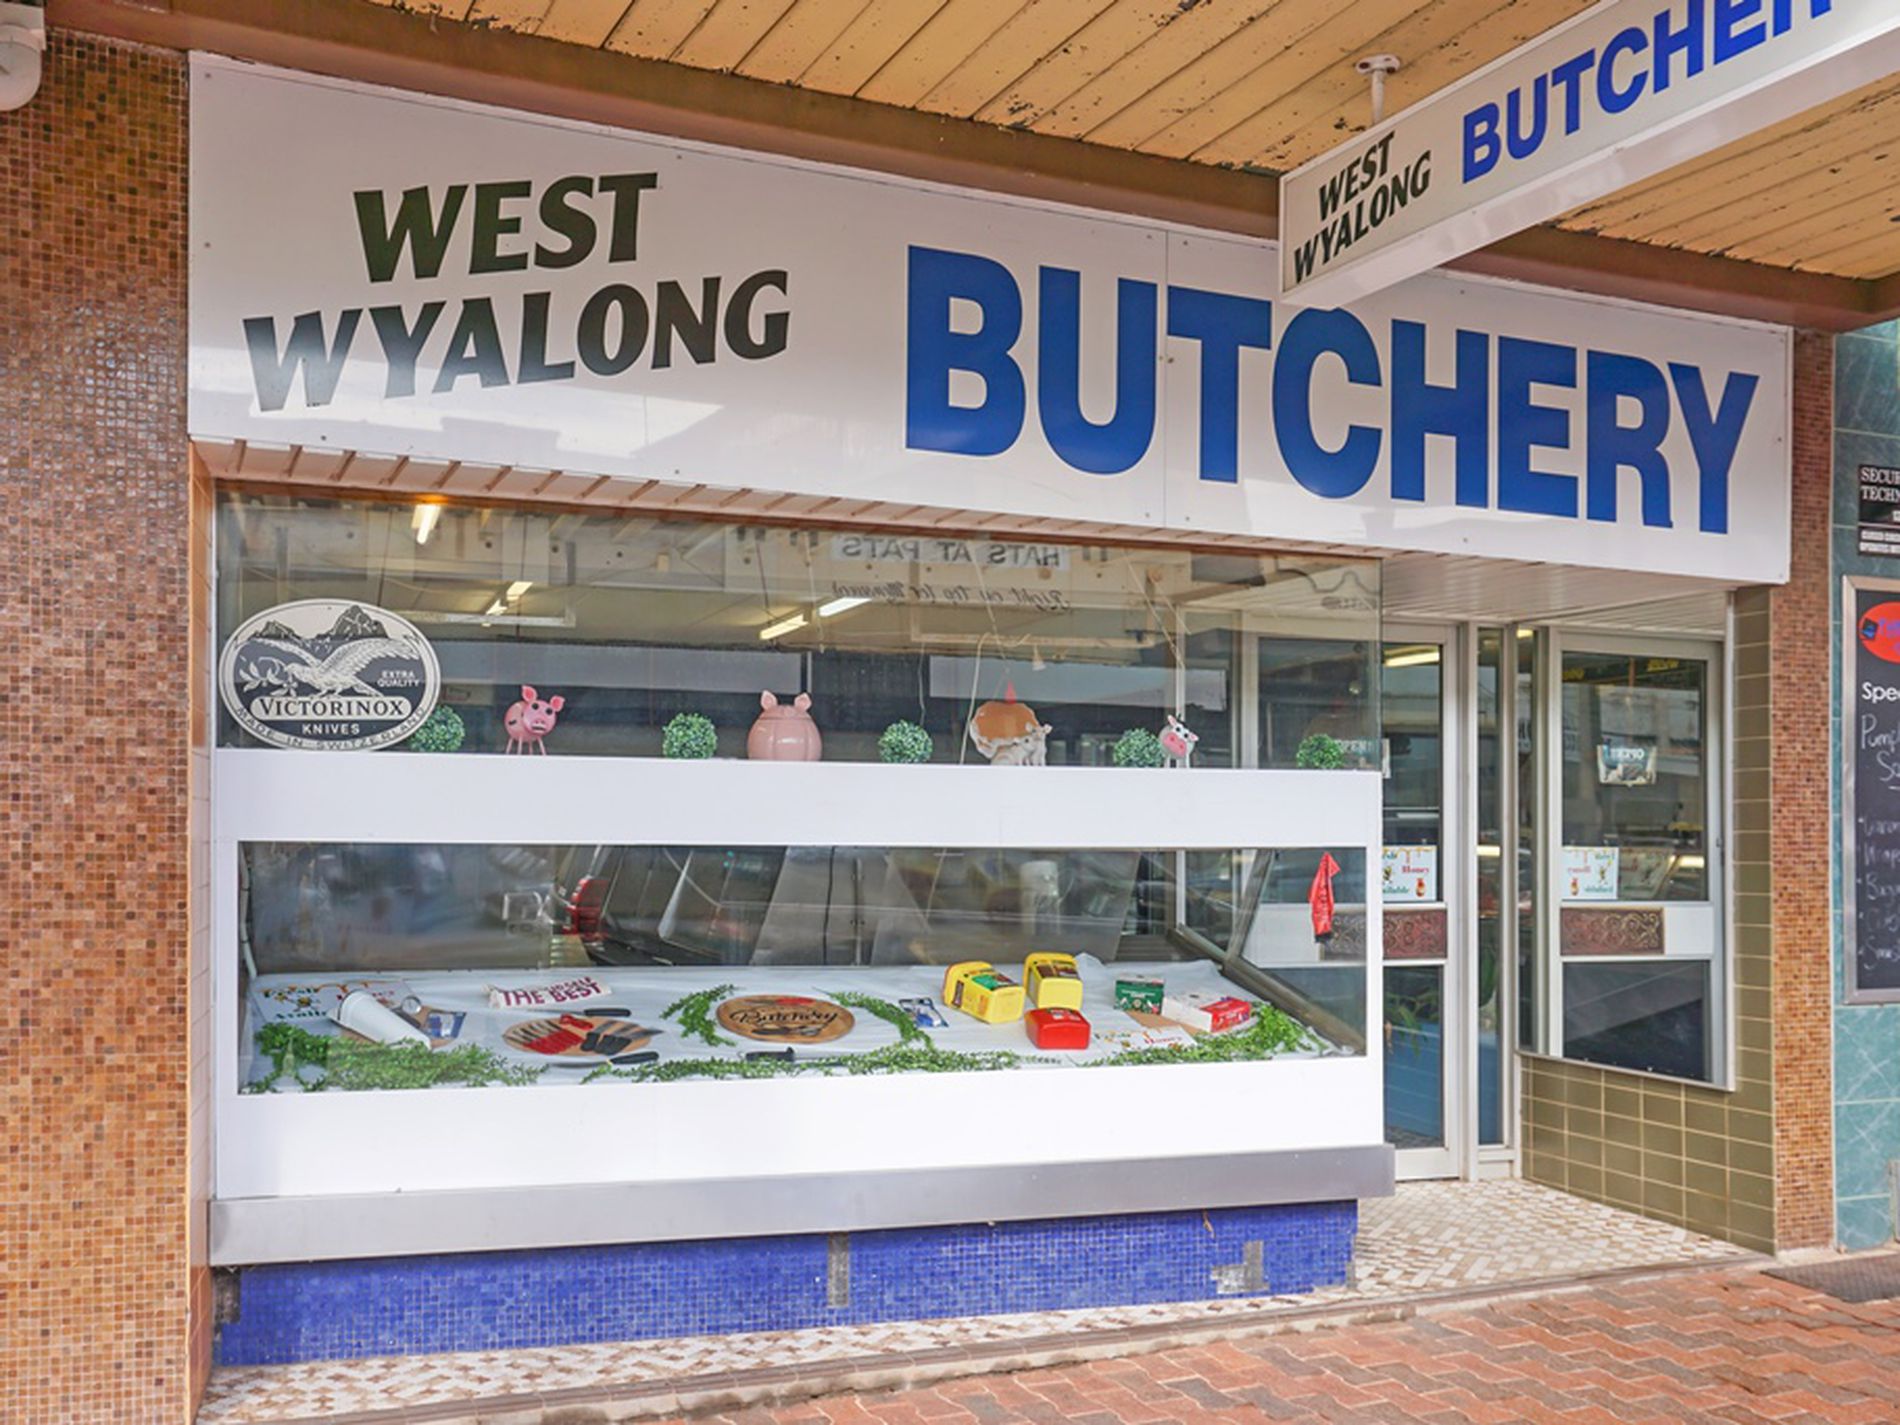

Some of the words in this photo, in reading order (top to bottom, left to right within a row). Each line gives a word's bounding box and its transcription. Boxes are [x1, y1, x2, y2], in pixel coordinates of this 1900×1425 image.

[1319, 130, 1395, 221] WEST
[353, 171, 658, 283] WEST
[1294, 149, 1431, 284] WYALONG
[242, 268, 790, 412] WYALONG
[905, 244, 1760, 534] BUTCHERY
[376, 679, 420, 688] QUALITY
[381, 671, 415, 679] EXTRA
[237, 707, 275, 739] MADE
[286, 735, 304, 746] IN
[315, 706, 424, 750] SWITZERLAND
[260, 698, 404, 716] VICTORINOX
[302, 724, 361, 735] KNIVES
[500, 989, 545, 1006] THE
[548, 981, 601, 1003] BEST
